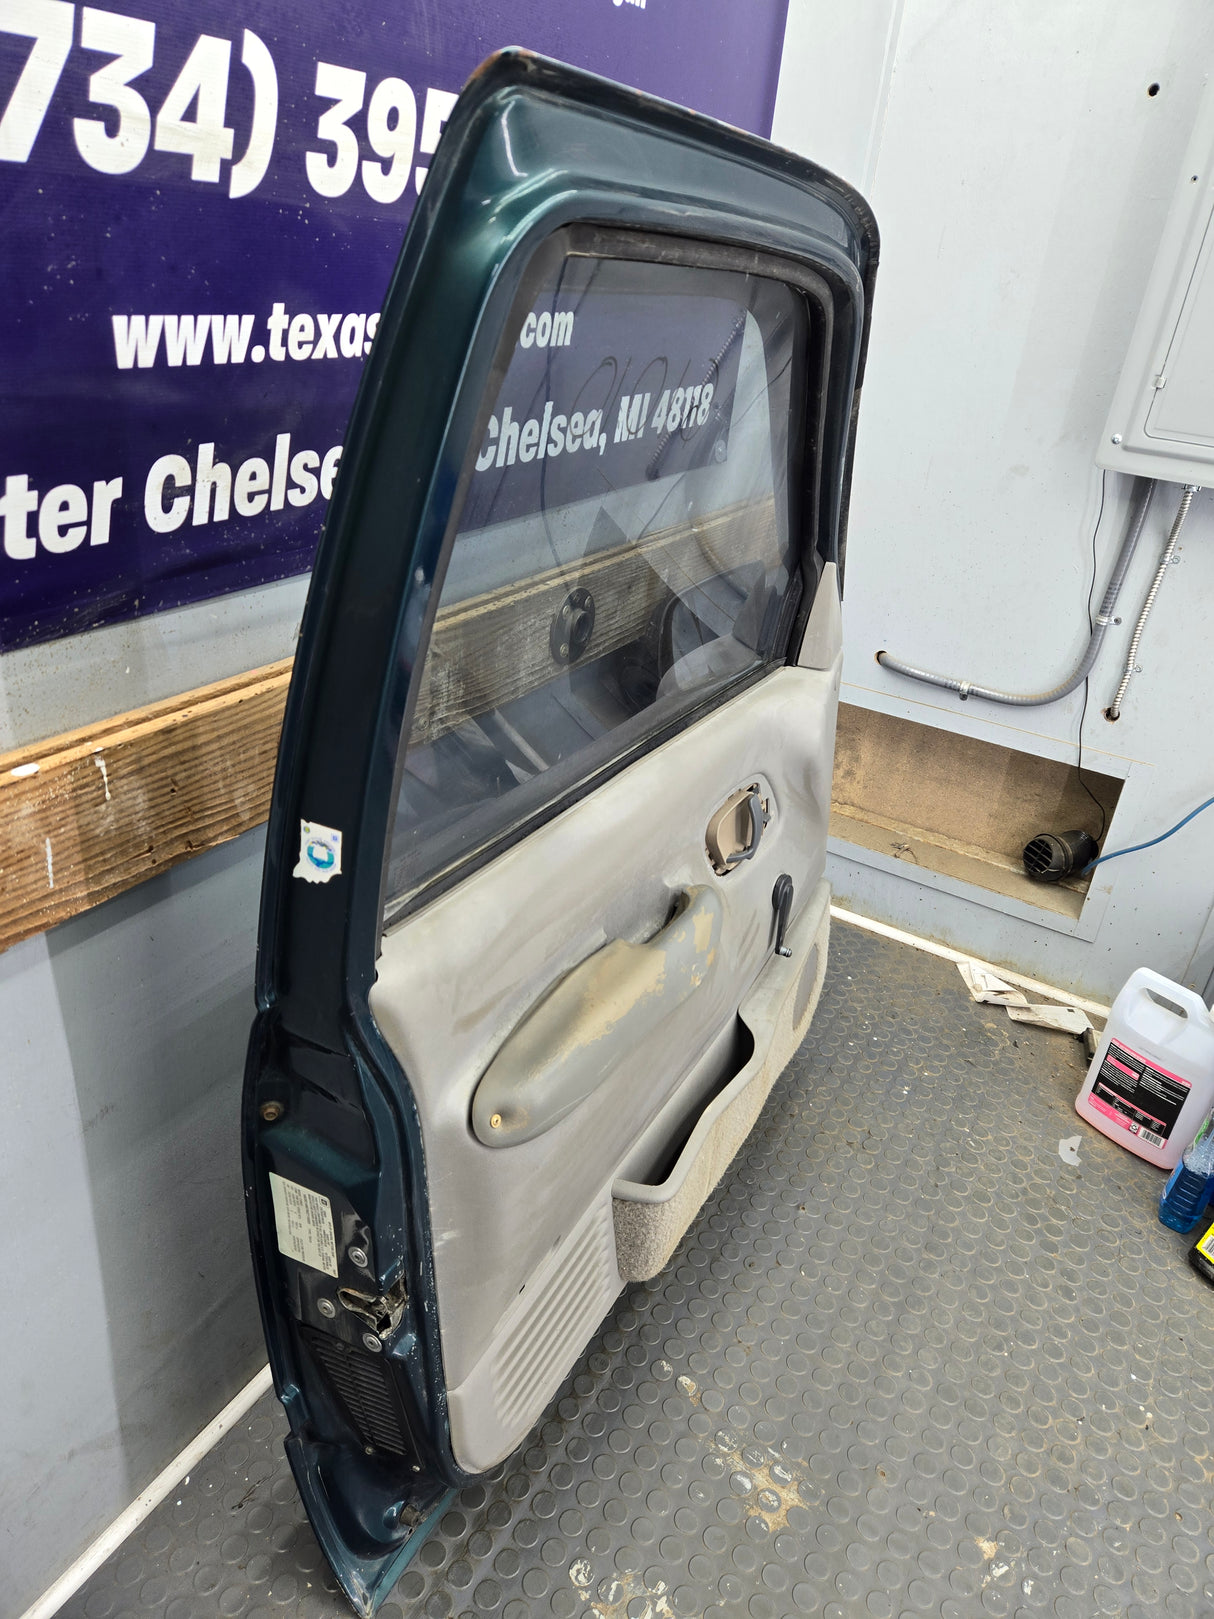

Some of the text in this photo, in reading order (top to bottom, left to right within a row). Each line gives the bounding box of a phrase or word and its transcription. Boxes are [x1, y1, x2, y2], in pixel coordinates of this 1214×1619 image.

[0, 0, 279, 200] 734)
[0, 473, 123, 560] ter
[474, 401, 607, 472] Chelsea,
[613, 392, 652, 444] MI
[650, 383, 715, 435] 48118
